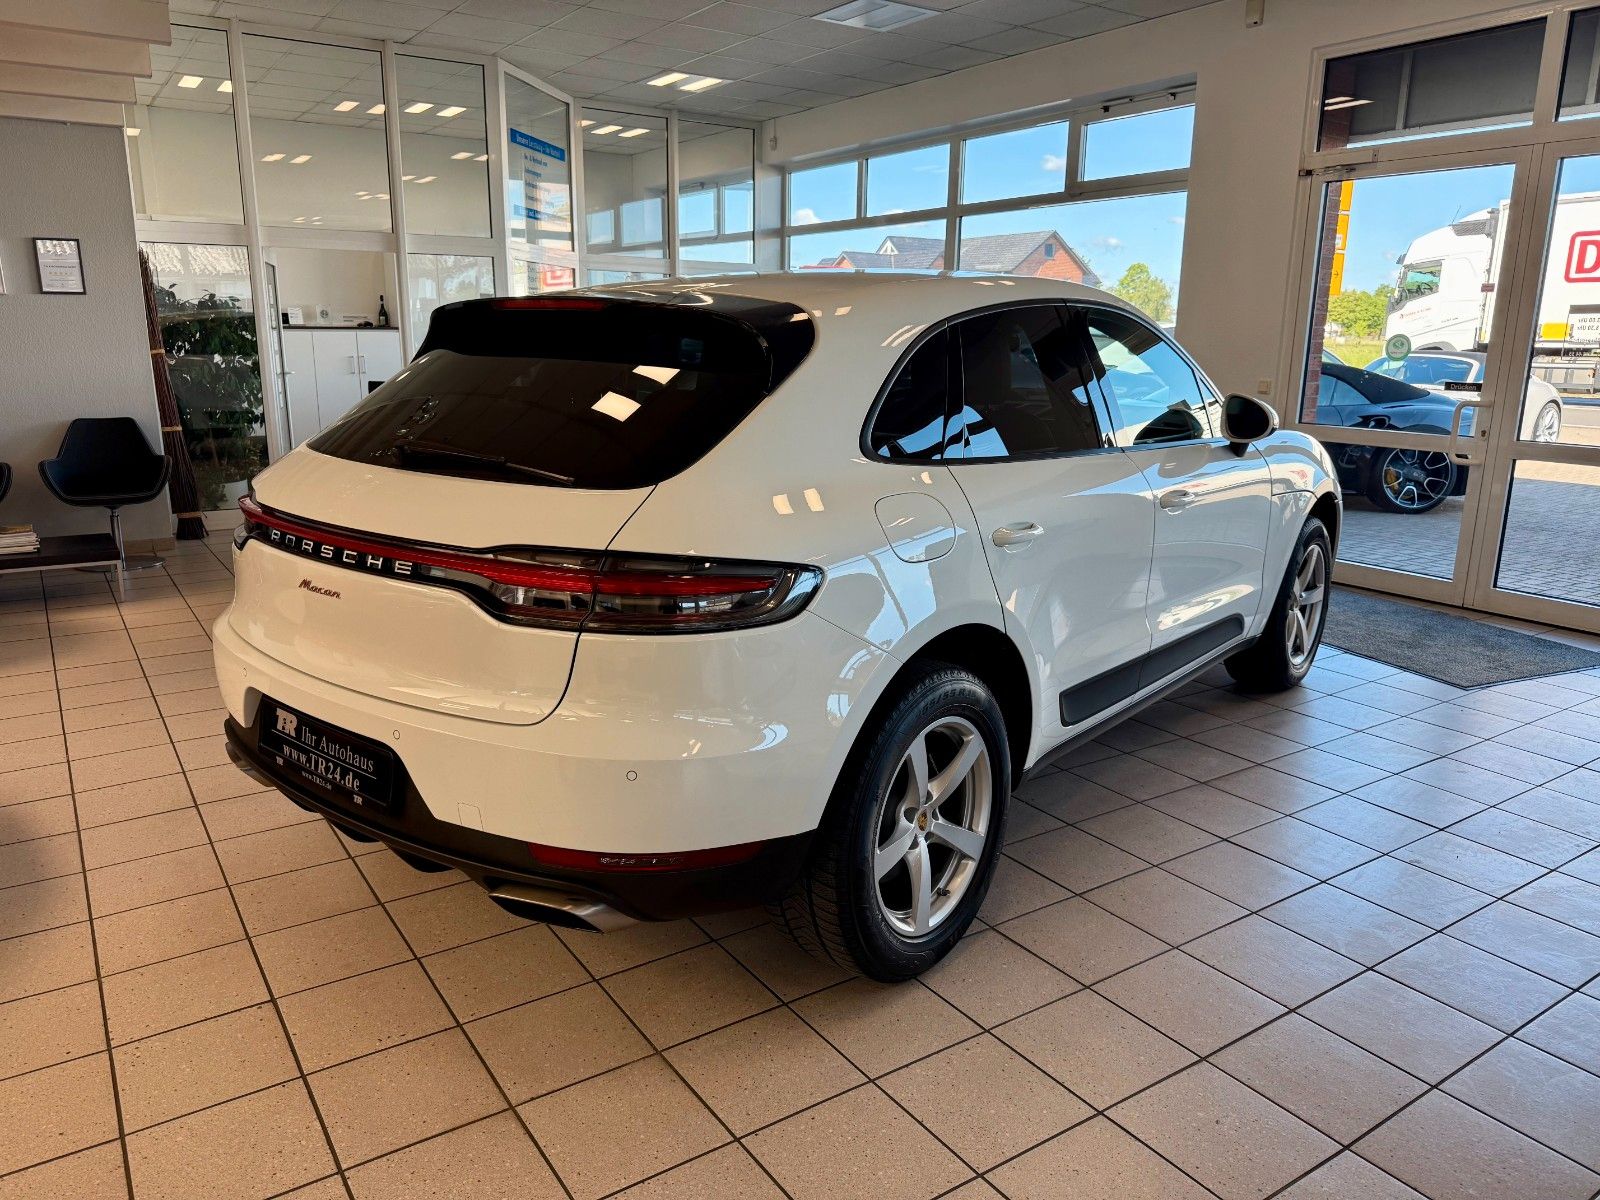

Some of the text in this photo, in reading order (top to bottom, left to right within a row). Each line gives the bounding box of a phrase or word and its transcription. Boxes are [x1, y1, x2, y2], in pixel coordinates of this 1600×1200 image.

[1450, 383, 1477, 391] Drücken
[270, 529, 413, 575] PORSCHE
[298, 577, 342, 600] Macan
[301, 726, 317, 747] Ihr
[319, 735, 374, 773] Autohaus
[282, 744, 361, 791] www.TR24.de
[301, 770, 332, 791] www.TR24.de
[353, 794, 363, 805] TR
